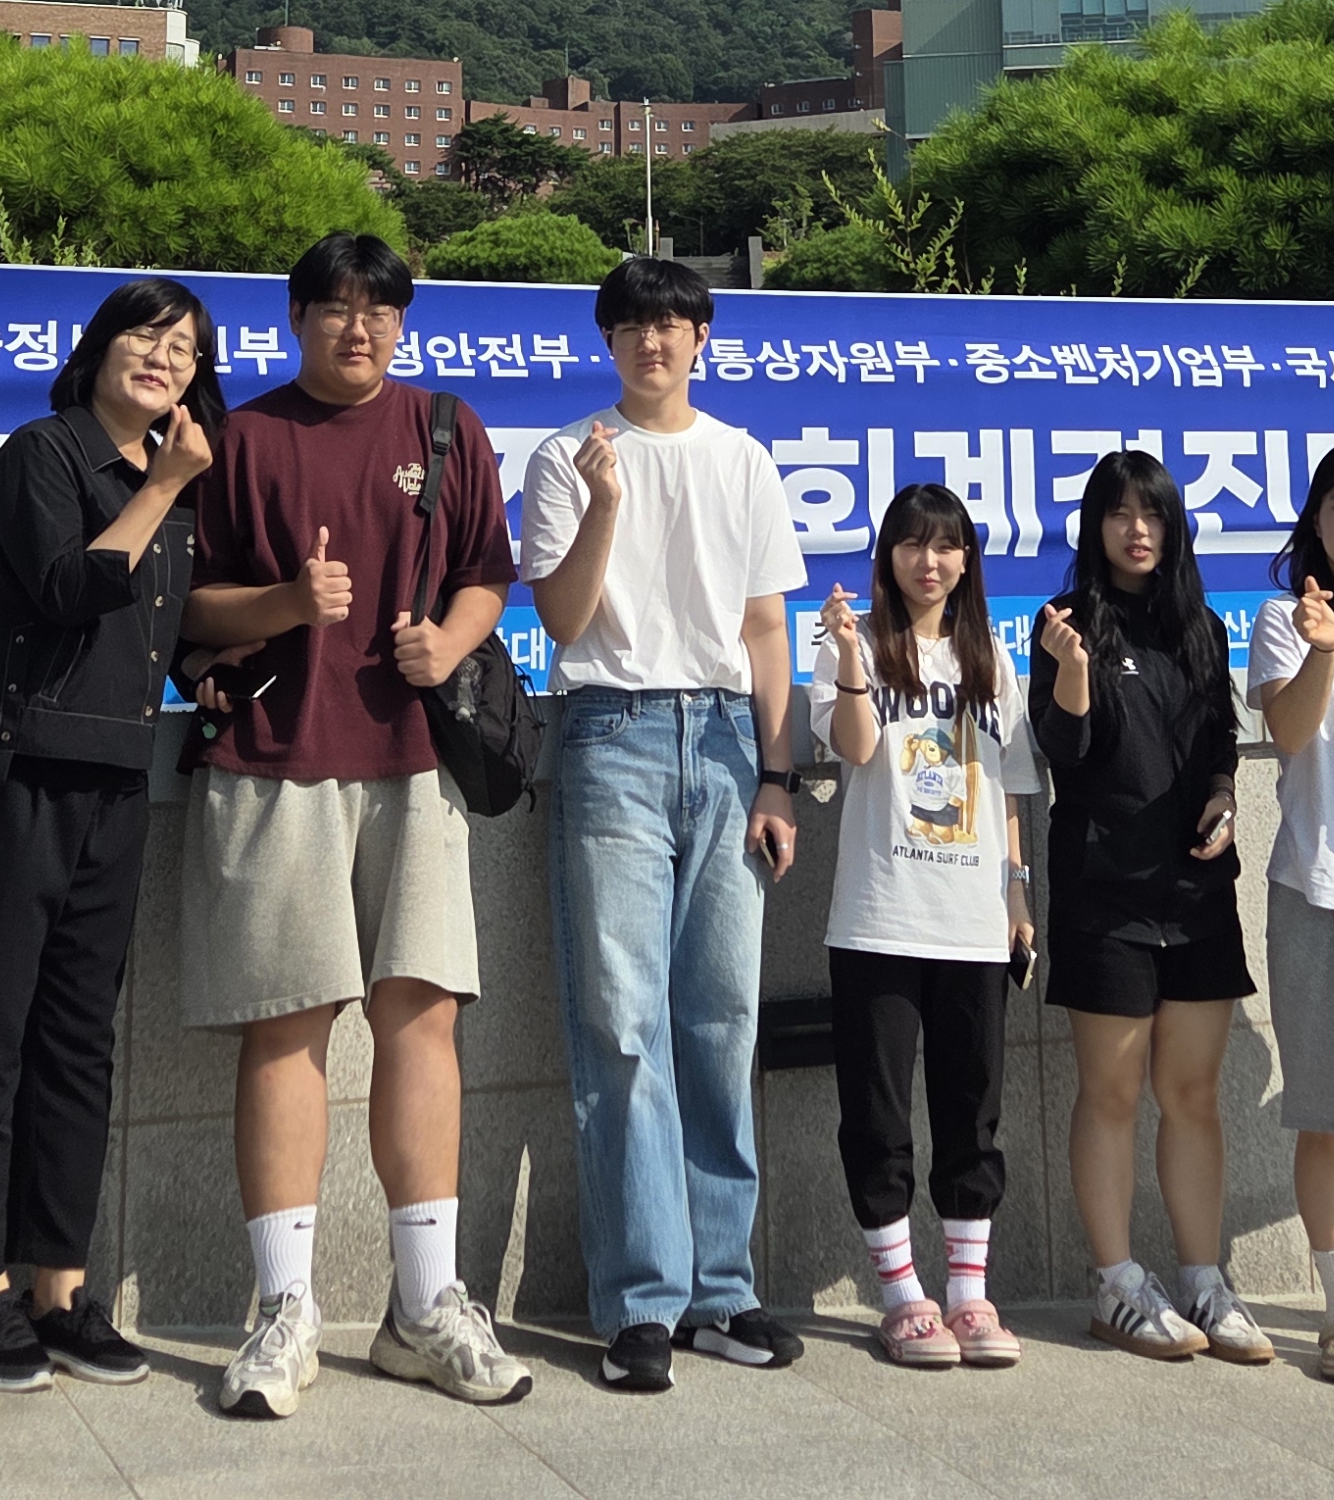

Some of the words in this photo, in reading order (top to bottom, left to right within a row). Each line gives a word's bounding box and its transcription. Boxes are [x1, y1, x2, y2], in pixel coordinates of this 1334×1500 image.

[893, 845, 934, 863] ATLANTA
[936, 851, 959, 866] SURF
[961, 853, 980, 867] CLUB
